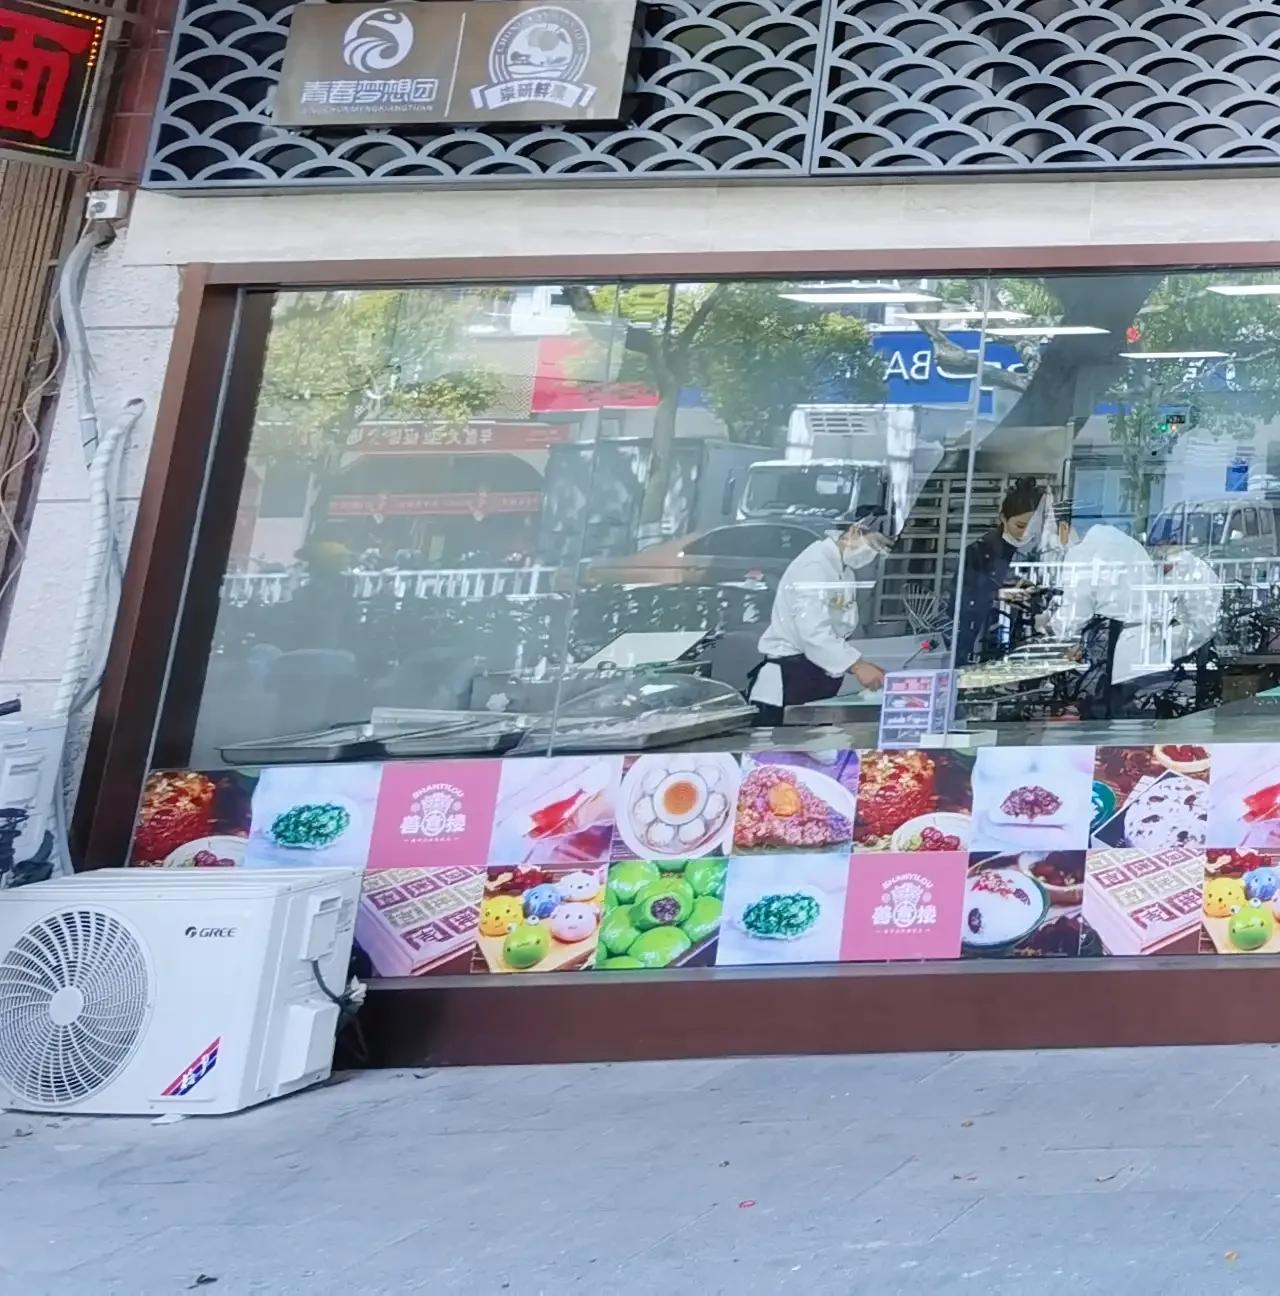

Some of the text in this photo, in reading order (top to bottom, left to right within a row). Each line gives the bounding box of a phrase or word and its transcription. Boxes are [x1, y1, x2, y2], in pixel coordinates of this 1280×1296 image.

[301, 77, 439, 104] 青春梦想团
[200, 927, 237, 938] GREE
